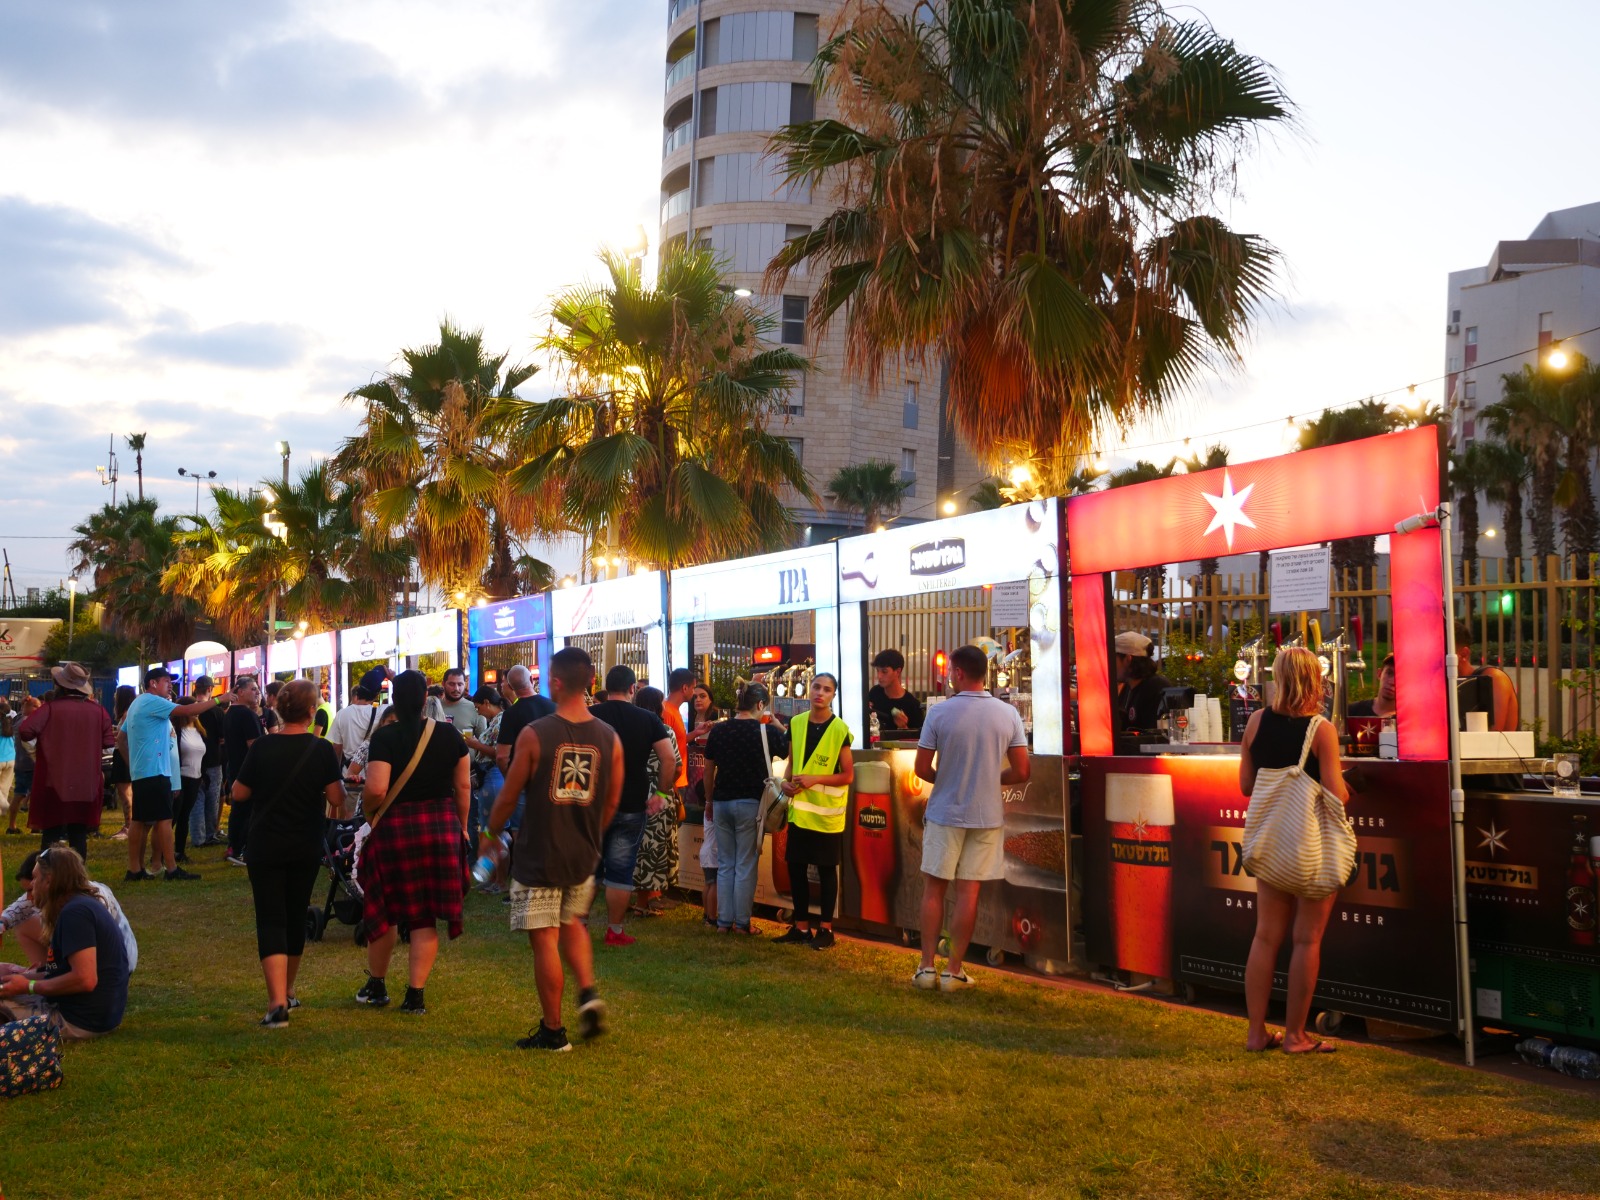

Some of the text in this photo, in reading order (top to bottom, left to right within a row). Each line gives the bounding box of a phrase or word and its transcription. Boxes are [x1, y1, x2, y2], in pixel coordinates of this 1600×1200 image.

[778, 567, 810, 605] IPA
[1349, 816, 1385, 828] BEER
[1111, 842, 1170, 863] גולדסטאר
[1465, 865, 1533, 885] גולדסטא
[1226, 897, 1384, 926] DAR BEER
